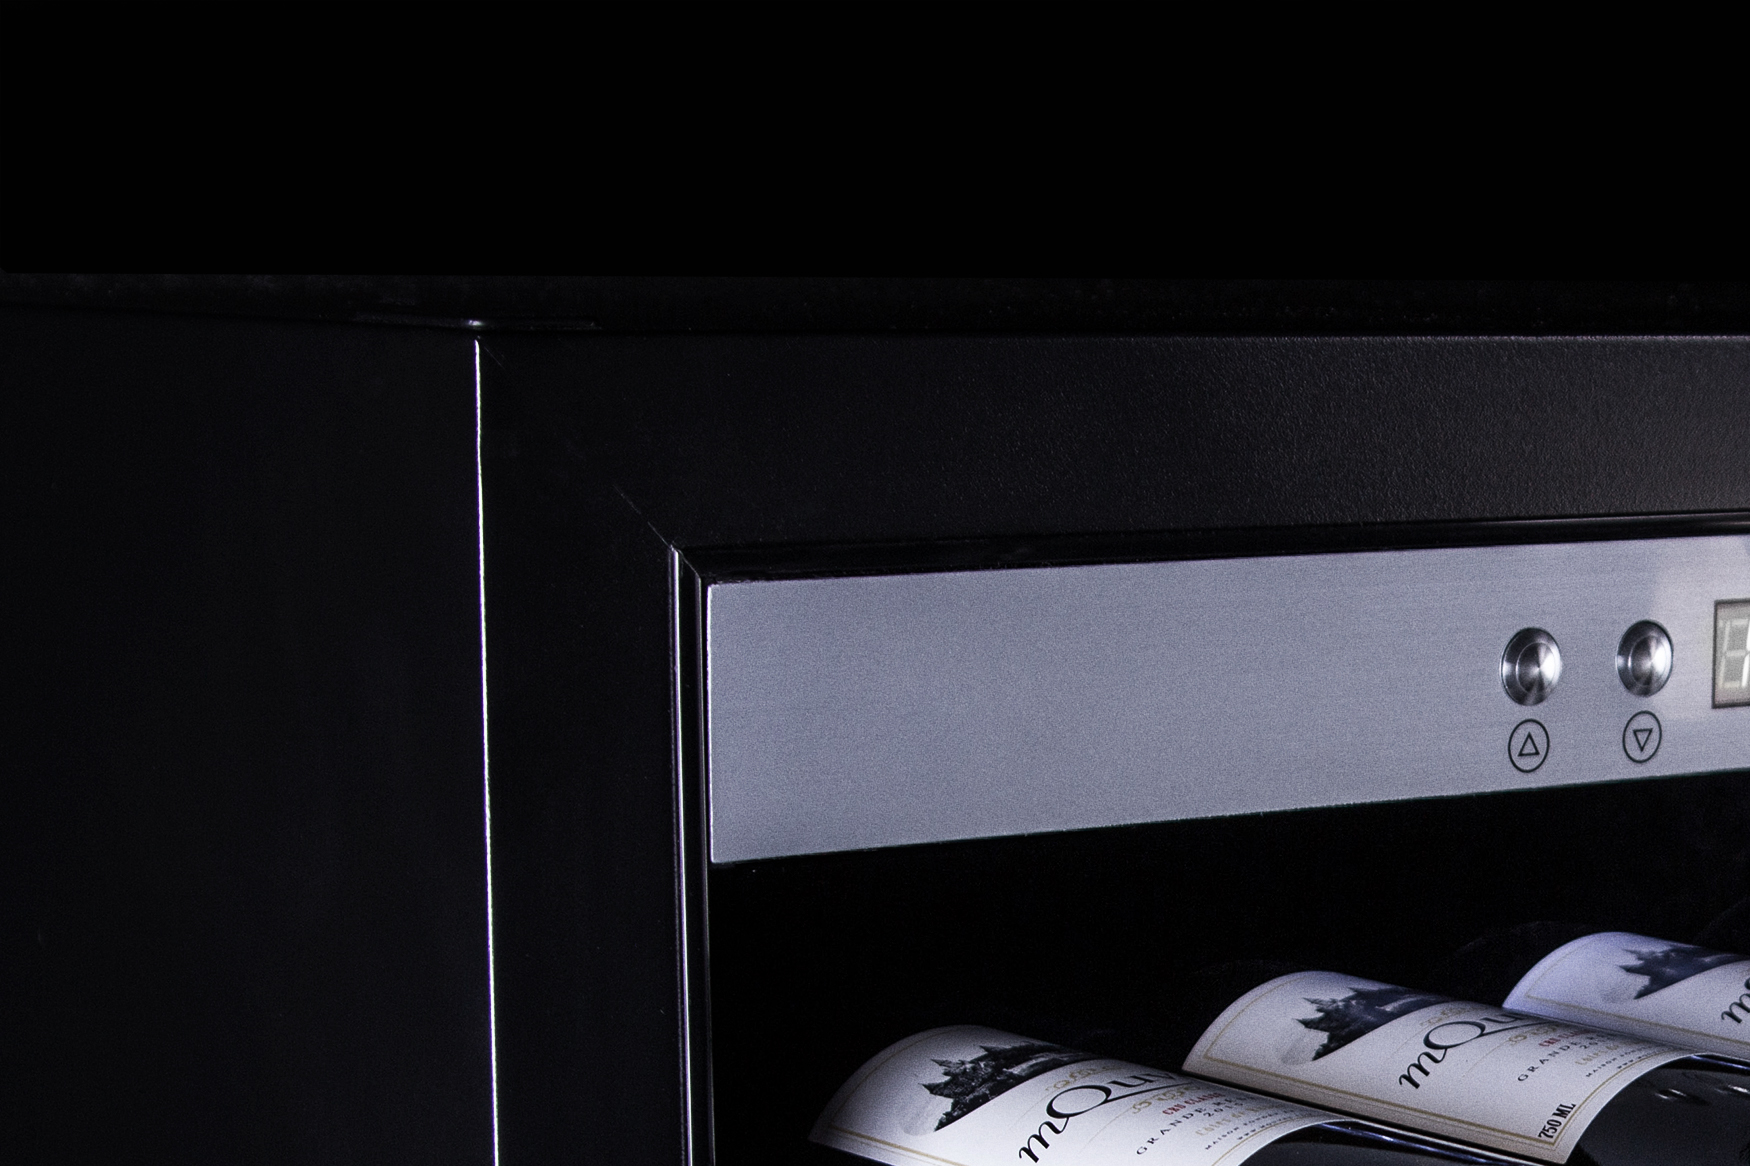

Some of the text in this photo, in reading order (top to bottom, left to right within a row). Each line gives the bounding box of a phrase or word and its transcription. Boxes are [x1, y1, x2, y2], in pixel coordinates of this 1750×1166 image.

[1135, 1105, 1206, 1156] GRANDE
[1537, 1103, 1577, 1139] 750 ML
